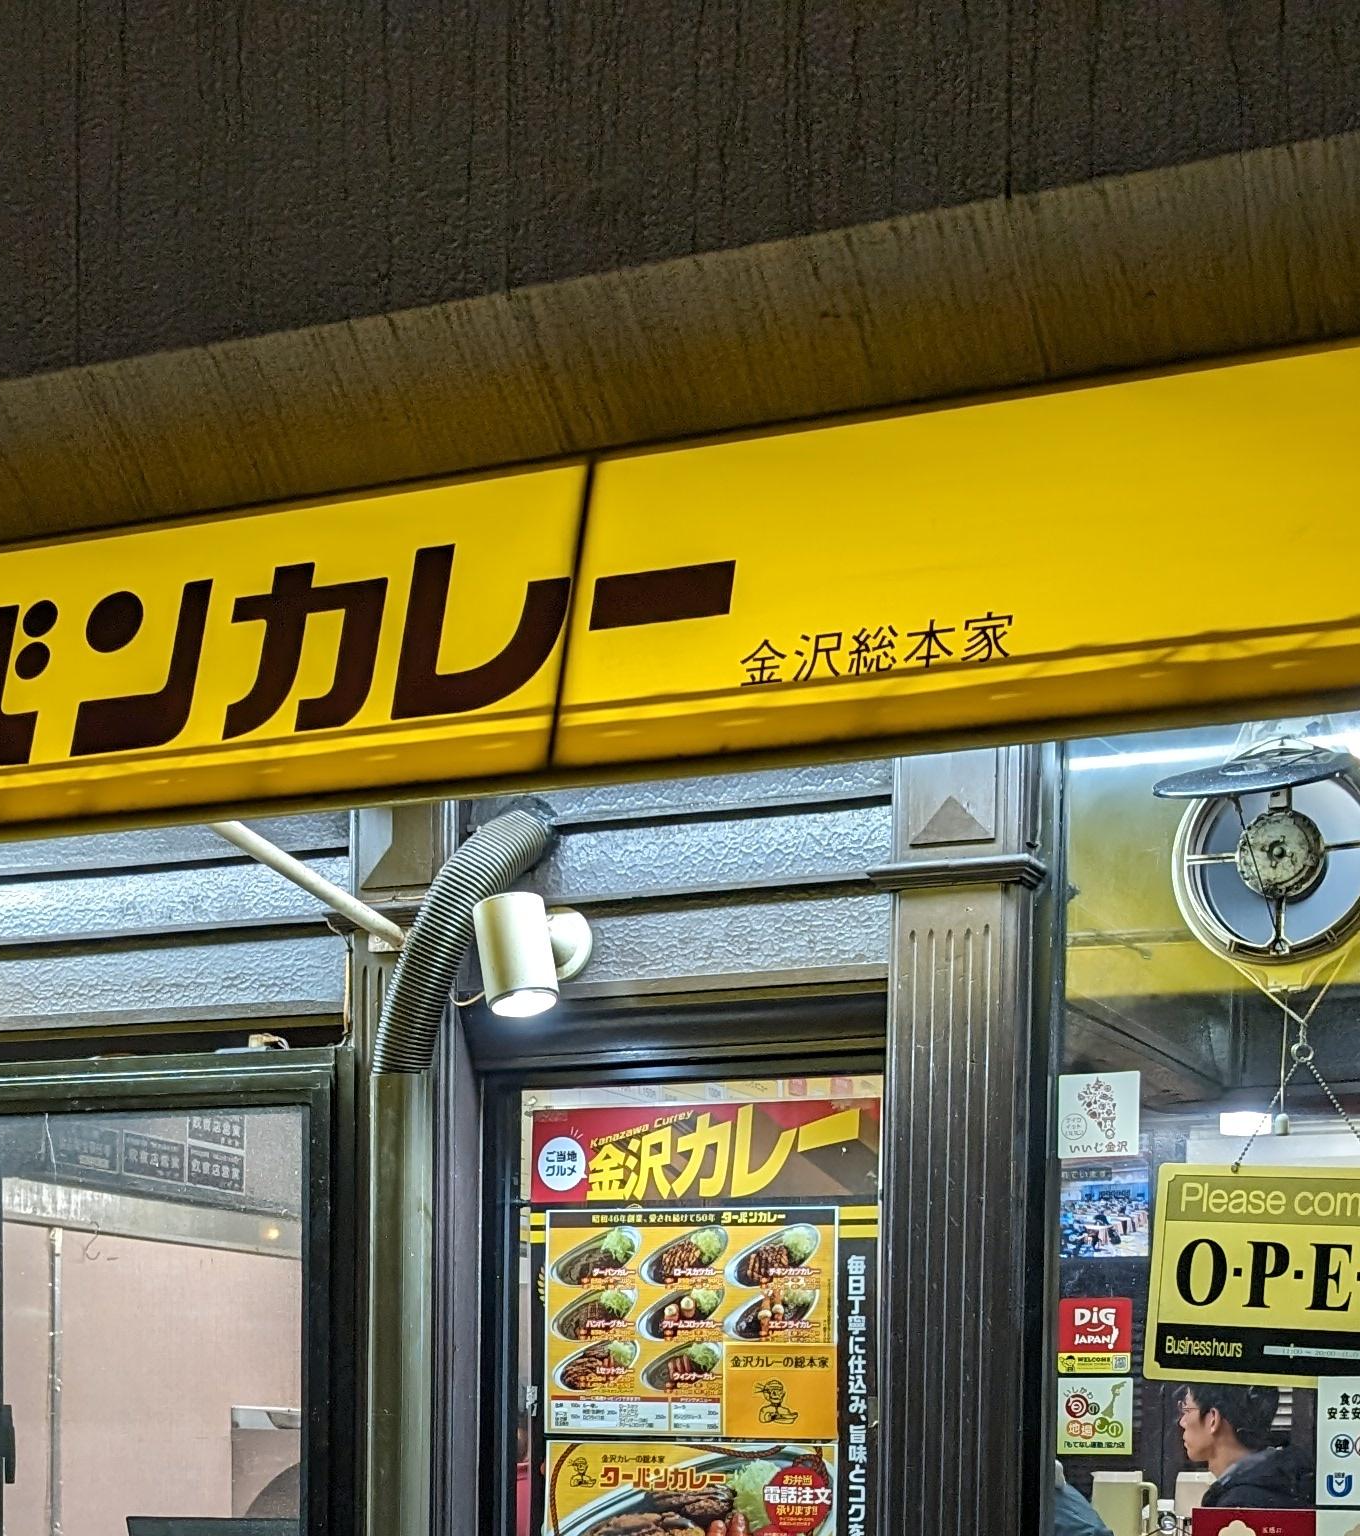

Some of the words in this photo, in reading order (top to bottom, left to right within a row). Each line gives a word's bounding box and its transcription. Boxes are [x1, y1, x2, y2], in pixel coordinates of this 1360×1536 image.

[740, 610, 1015, 688] 金沢総本家
[589, 1124, 649, 1149] Kanazawa
[654, 1109, 694, 1129] Currey
[545, 1150, 577, 1163] ご当地
[586, 1103, 861, 1202] 金沢カレー
[1069, 1140, 1129, 1154] いいじ金沢
[545, 1165, 577, 1177] グルメ
[1180, 1182, 1286, 1217] Please
[721, 1211, 786, 1224] ターバンカレー
[730, 1355, 830, 1369] 金沢カレーの総本家
[599, 1466, 726, 1490] ターバンカレー
[764, 1486, 832, 1505] 電話注文
